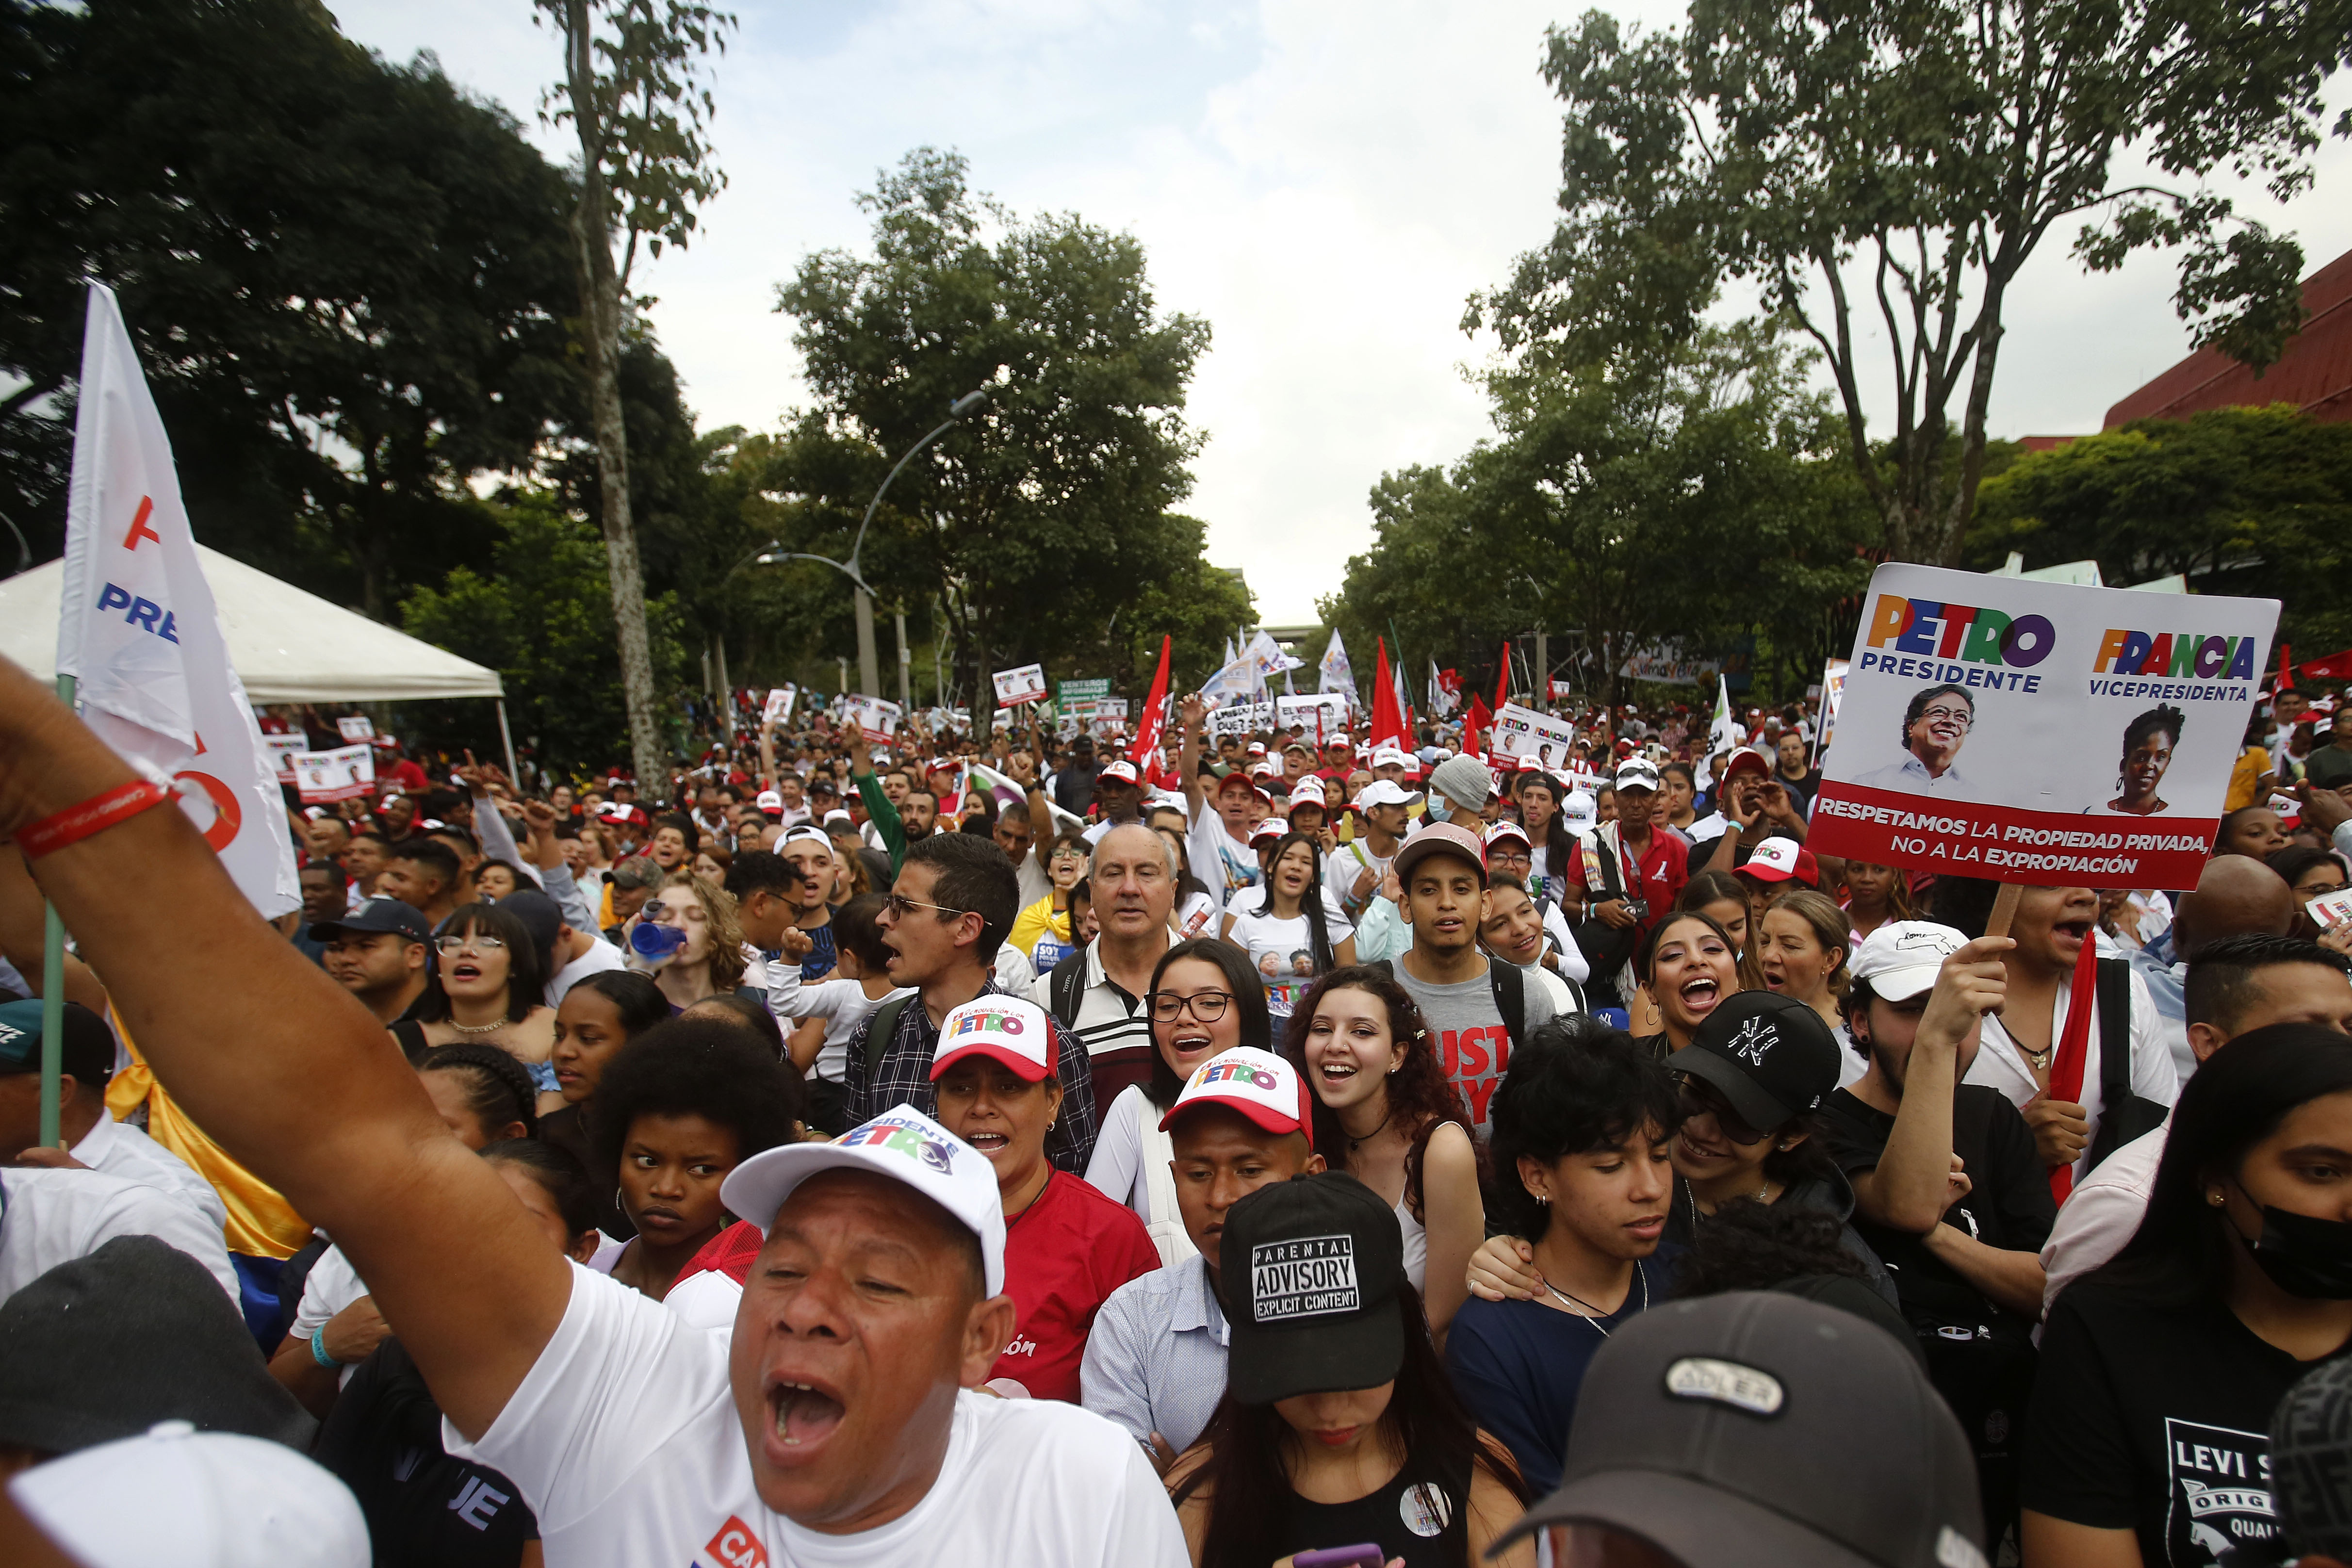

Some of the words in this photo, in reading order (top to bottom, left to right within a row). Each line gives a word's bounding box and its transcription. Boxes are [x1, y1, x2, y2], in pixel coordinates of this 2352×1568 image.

[1866, 593, 2056, 668] PETRO
[2092, 629, 2254, 680] FRANCIA
[1060, 679, 1108, 688] VENTEROS
[1860, 652, 2042, 693] PRESIDENTE
[2090, 679, 2247, 701] VICEPRESIDENTA
[1296, 705, 1318, 715] VOTO
[1502, 717, 1529, 732] PETRO
[1535, 726, 1568, 743] FRANCIA
[1818, 798, 1967, 836] RESPETAMOS
[1970, 822, 1998, 839] LA
[2003, 825, 2123, 849] PROPIEDAD
[2124, 834, 2209, 855] PRIVADA,
[1890, 835, 1926, 855] NO
[1929, 842, 1946, 858] A
[1952, 844, 1980, 862] LA
[1984, 848, 2139, 874] EXPROPIACIÓN
[1039, 946, 1059, 956] SOY
[964, 1007, 1009, 1017] Renovación
[948, 1013, 1024, 1040] PETRO
[1428, 1025, 1510, 1078] UST
[1192, 1064, 1276, 1090] PETRO
[1212, 1058, 1262, 1069] Renovación
[1264, 1067, 1280, 1076] con
[1255, 1241, 1349, 1265] PARENTAL
[1257, 1258, 1349, 1296] ADVISORY
[1257, 1296, 1300, 1317] EXPLICIT
[1305, 1290, 1355, 1311] CONTENT
[2176, 1440, 2246, 1478] LEVI
[2195, 1492, 2265, 1508] ORIG
[720, 1530, 767, 1568] CA
